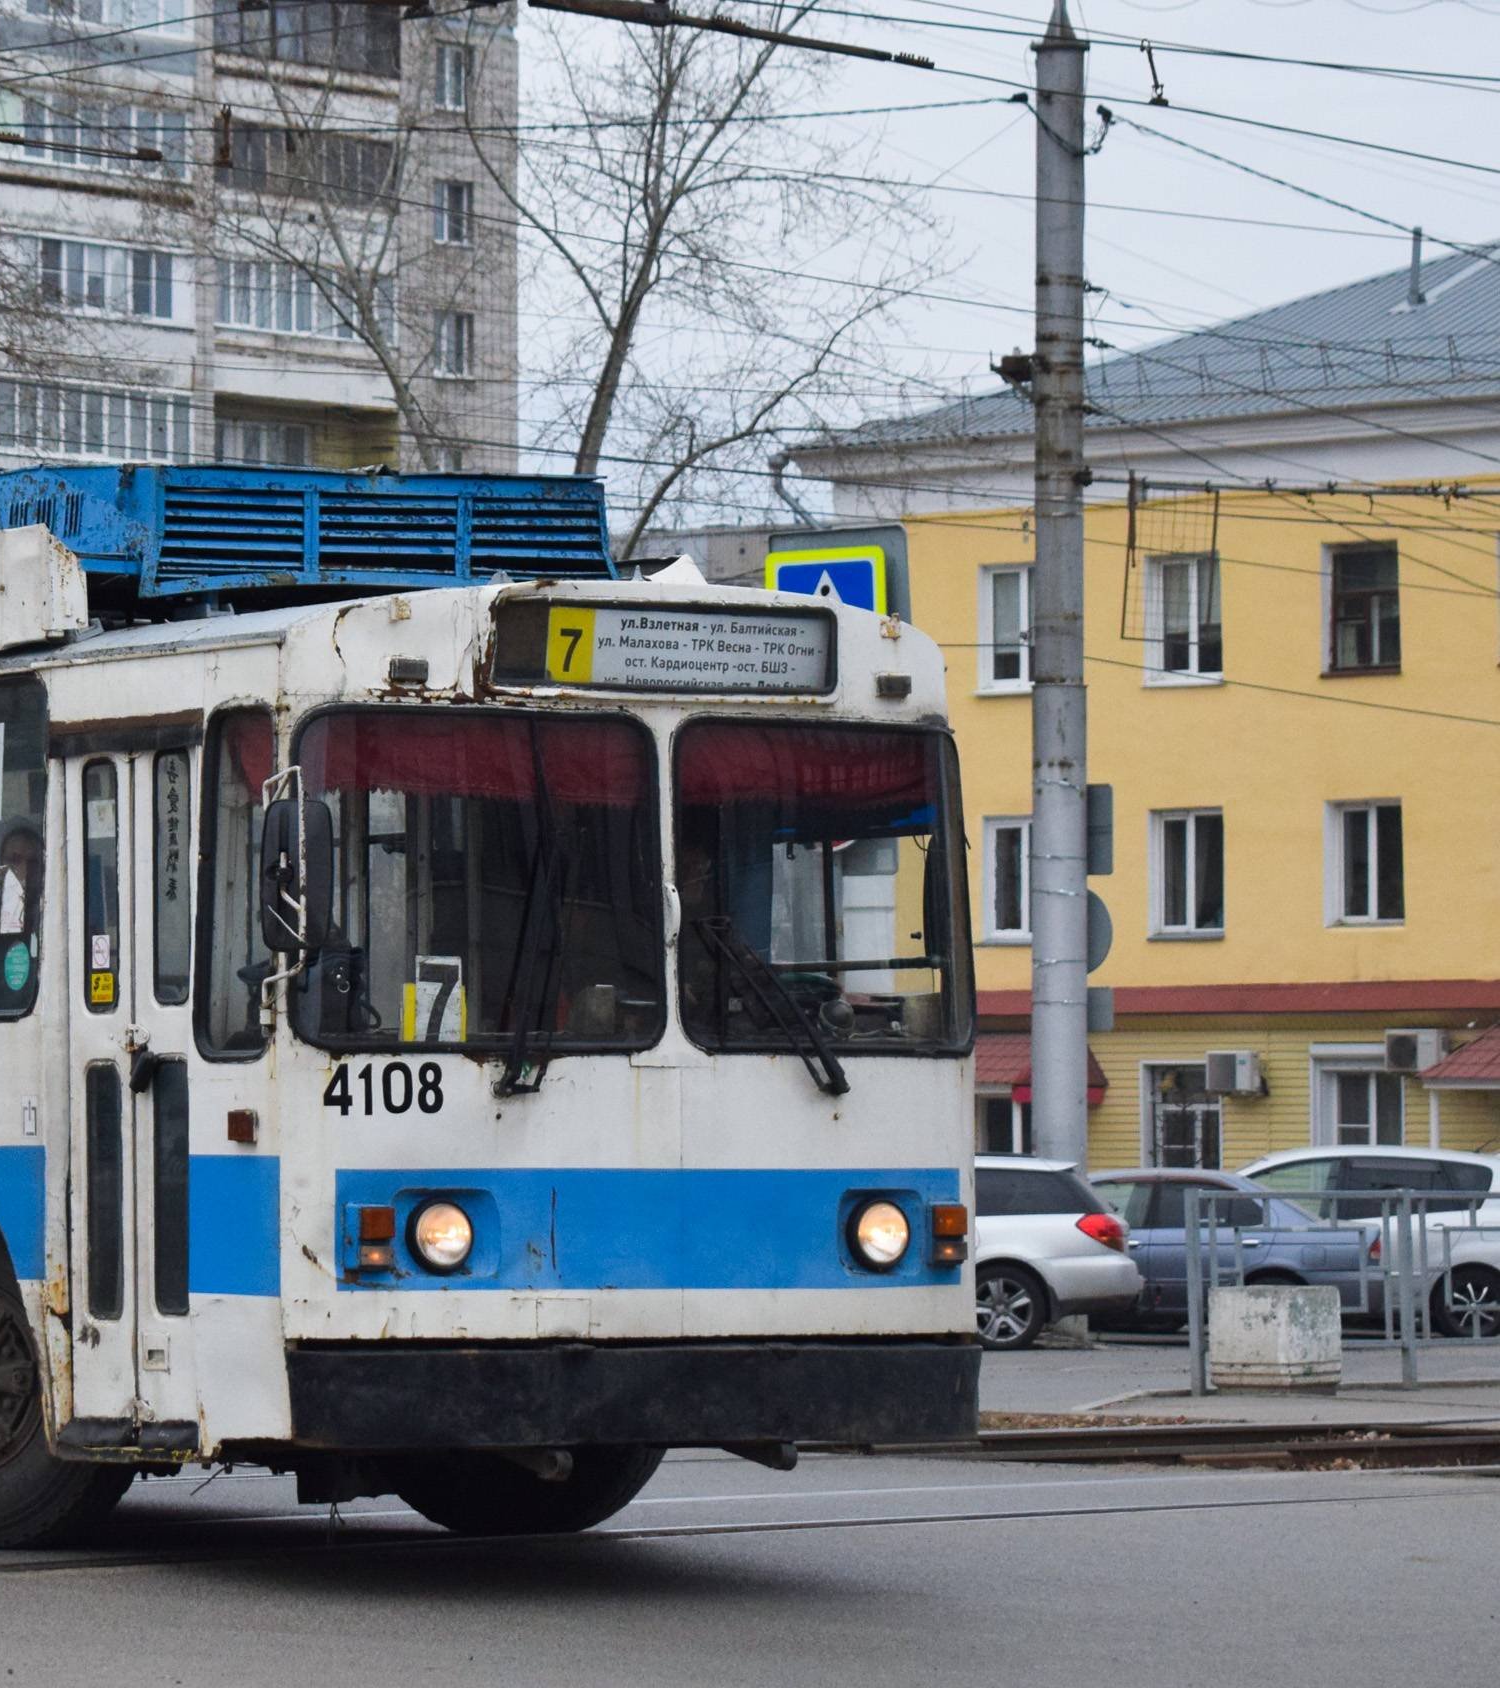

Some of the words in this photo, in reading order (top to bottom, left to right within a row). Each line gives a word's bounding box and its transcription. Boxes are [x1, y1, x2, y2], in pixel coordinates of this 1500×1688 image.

[620, 617, 699, 632] ул.Взлетная
[710, 623, 727, 635] ул.
[730, 621, 797, 637] Балтийская
[560, 628, 583, 673] 7
[597, 637, 616, 649] ул.
[619, 635, 679, 650] Малахова
[691, 638, 714, 652] ТРК
[717, 640, 752, 654] Весна
[763, 642, 785, 656] ТРК
[787, 643, 815, 656] Огни
[624, 657, 647, 668] ост.
[650, 656, 729, 674] Кардиоцентр
[761, 661, 788, 674] БШЗ
[418, 963, 460, 1042] 7
[323, 1061, 444, 1116] 4108
